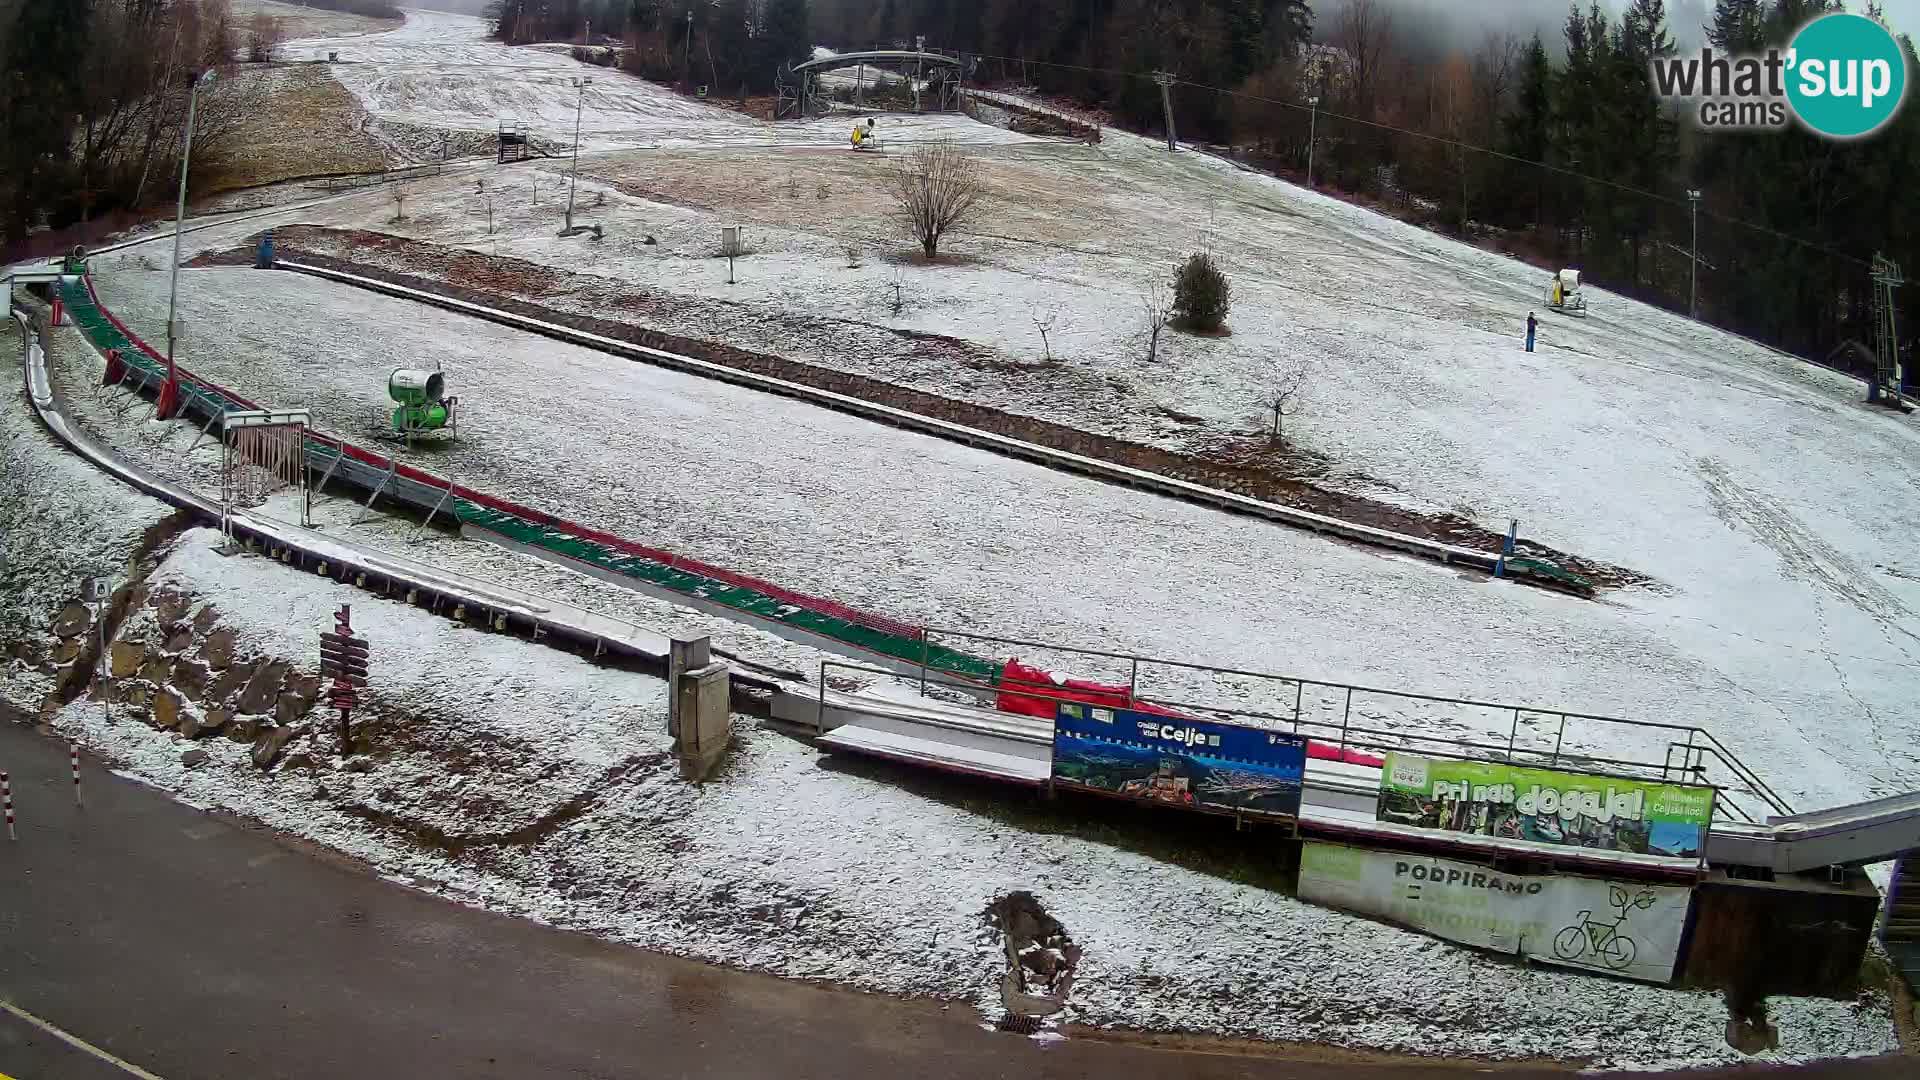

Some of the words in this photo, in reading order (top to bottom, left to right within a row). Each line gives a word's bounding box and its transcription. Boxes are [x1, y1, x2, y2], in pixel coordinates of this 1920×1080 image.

[1160, 724, 1206, 747] Celje
[1473, 784, 1515, 804] nas
[1395, 861, 1543, 895] PODPIRAMO
